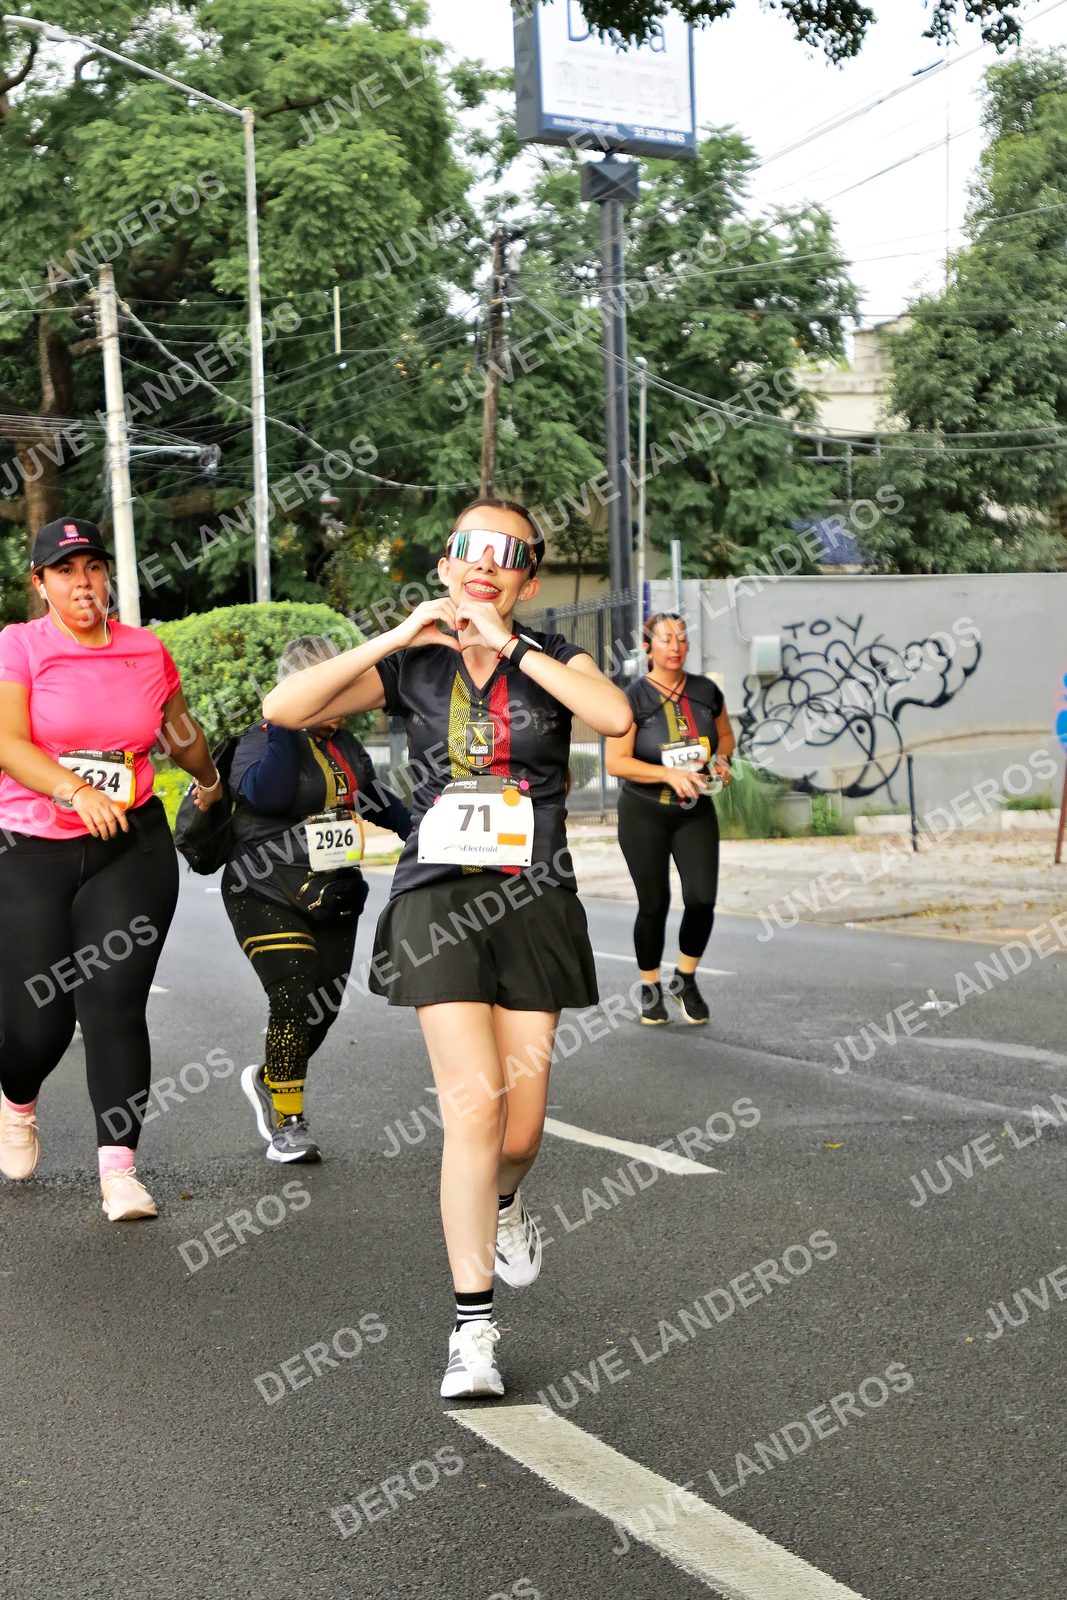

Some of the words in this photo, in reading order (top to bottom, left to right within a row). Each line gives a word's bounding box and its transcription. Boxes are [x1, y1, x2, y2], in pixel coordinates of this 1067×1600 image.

[782, 614, 864, 645] TOY
[71, 767, 120, 792] 624
[458, 804, 490, 832] 71
[315, 828, 354, 850] 2926
